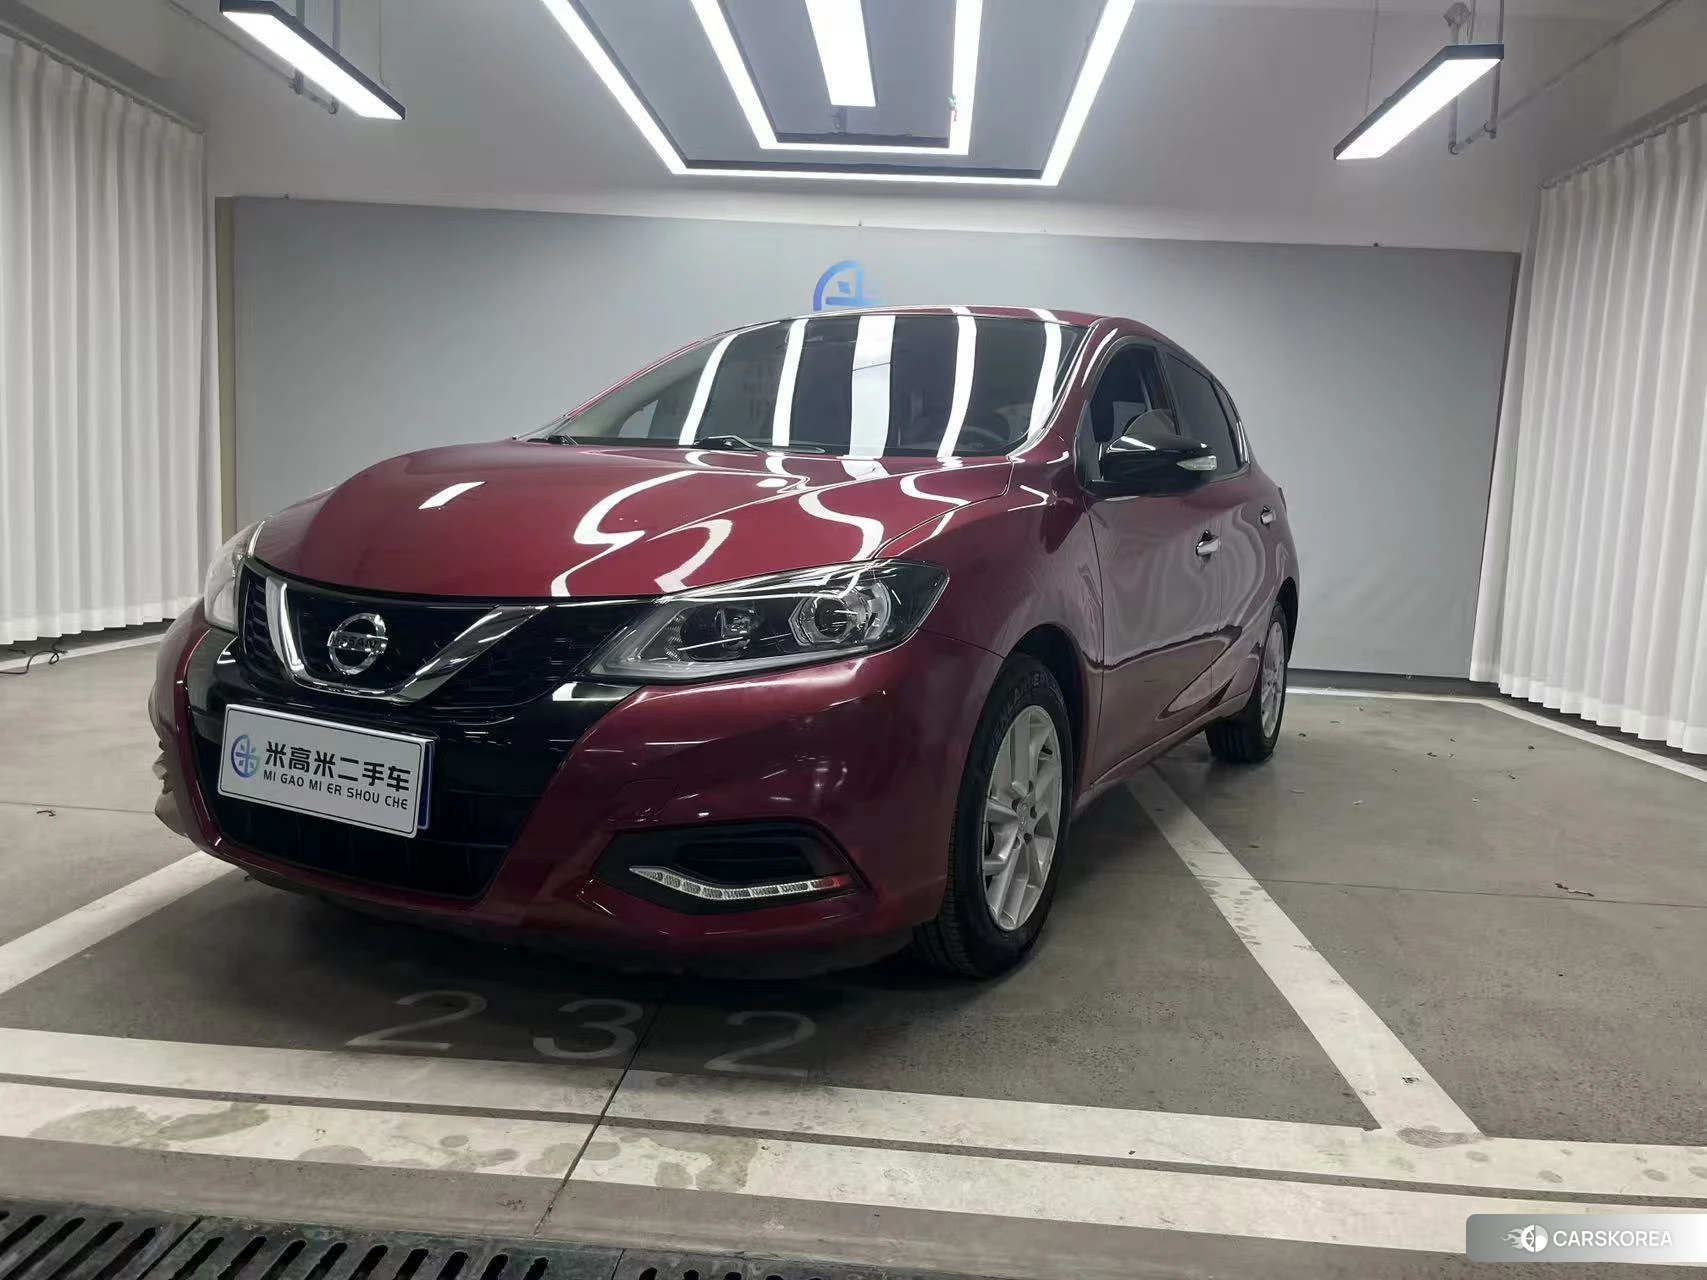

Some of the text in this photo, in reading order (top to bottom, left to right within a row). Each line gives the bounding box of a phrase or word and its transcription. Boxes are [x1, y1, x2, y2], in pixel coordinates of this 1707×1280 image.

[263, 769, 408, 810] MI GAO MI ER SHOU CHE
[264, 741, 411, 793] 米高米二手车
